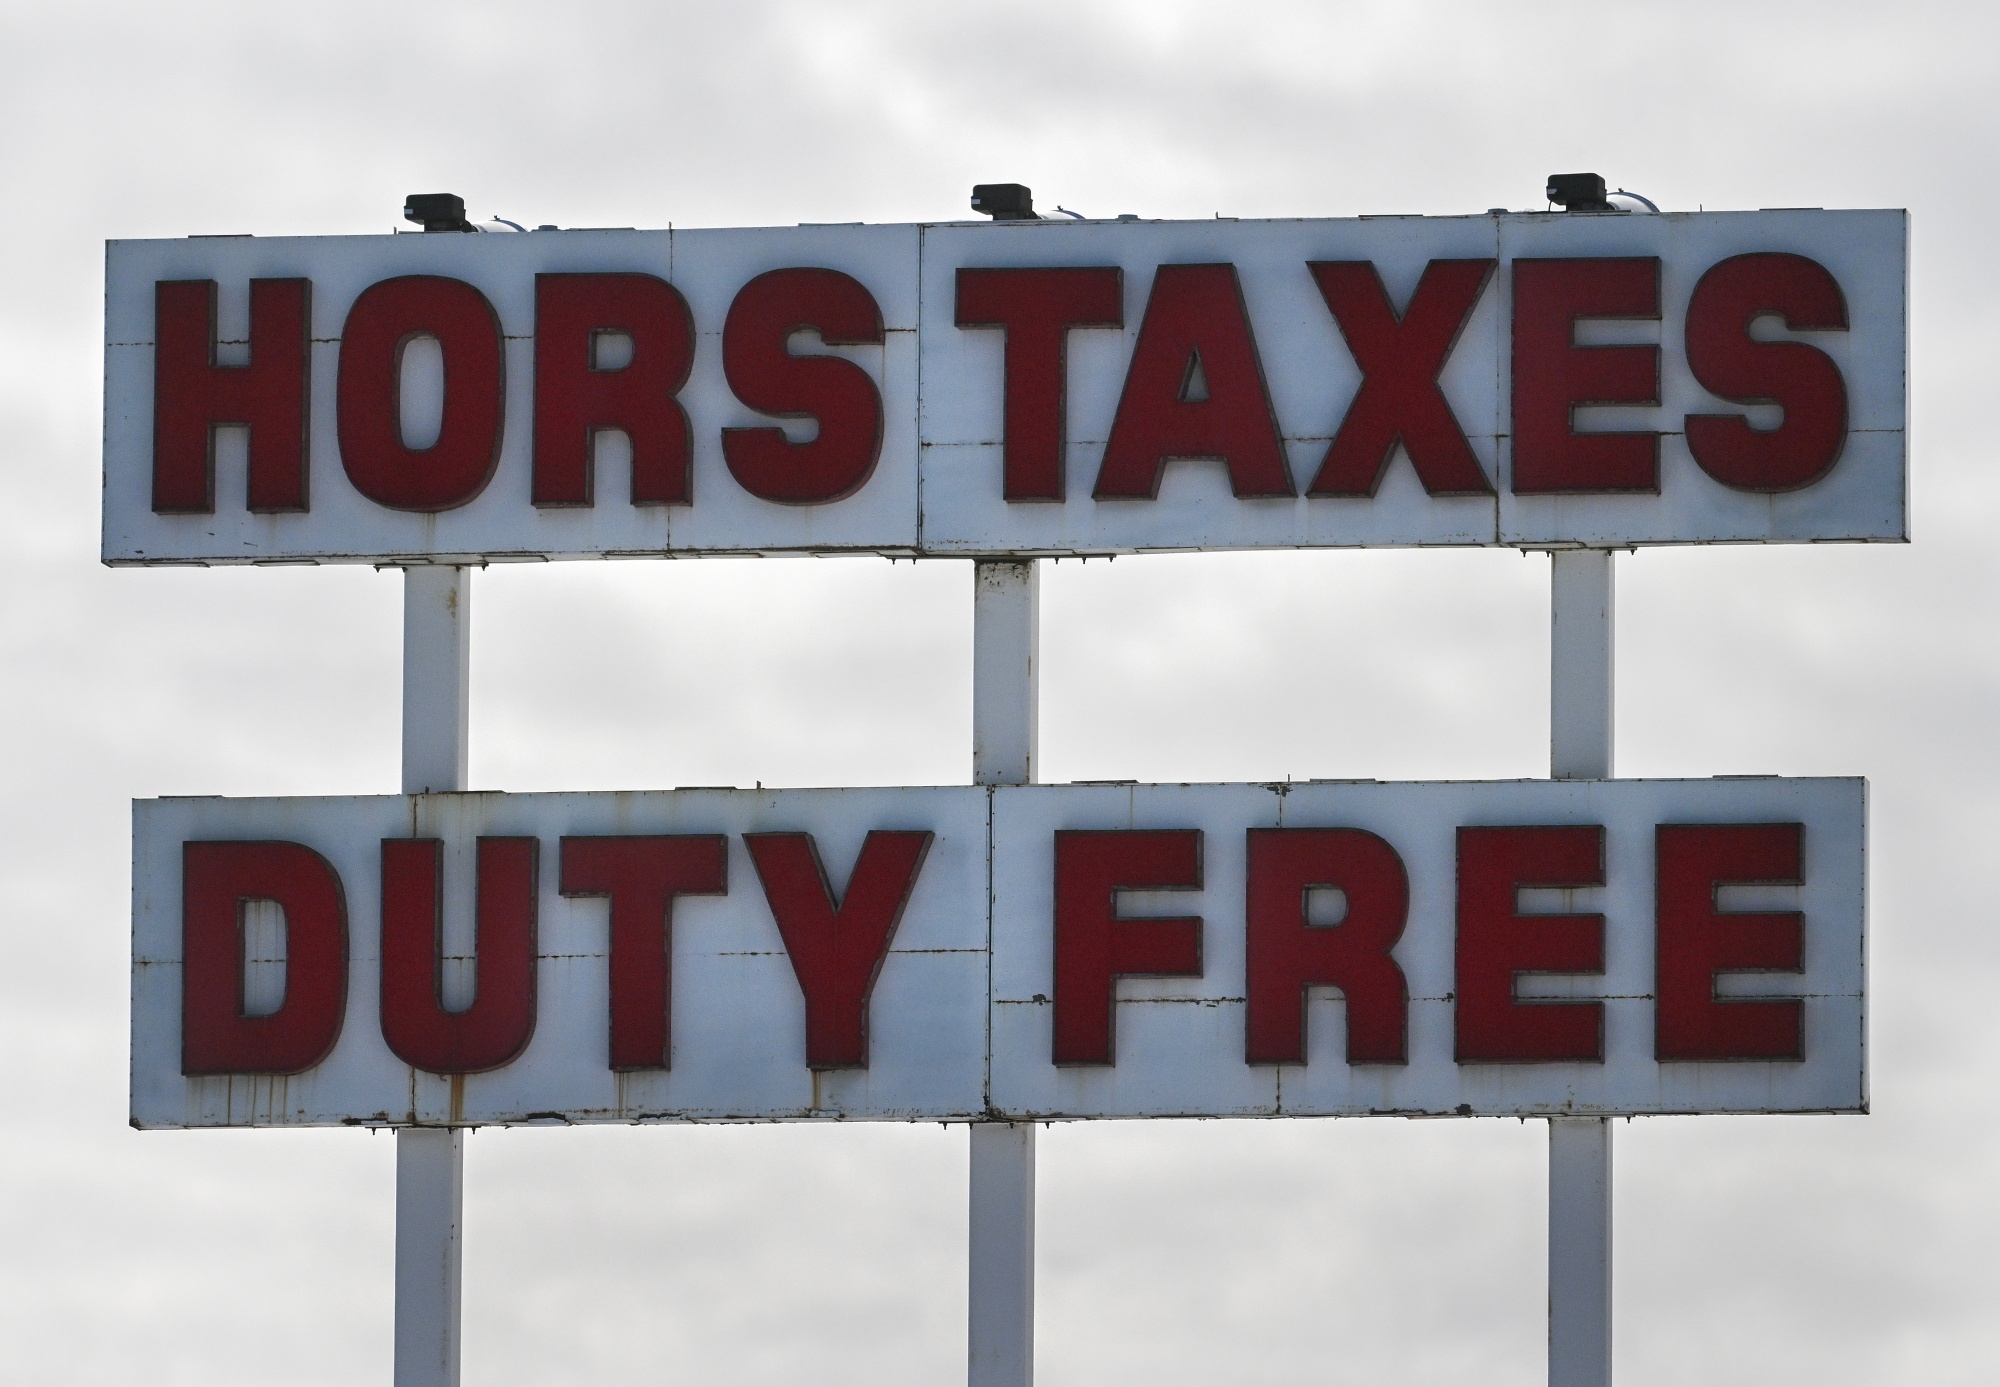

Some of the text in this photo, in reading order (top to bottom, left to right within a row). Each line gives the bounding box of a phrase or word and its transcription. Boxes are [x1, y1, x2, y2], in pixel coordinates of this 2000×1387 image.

[153, 253, 1849, 514] HORS TAXES
[182, 823, 1806, 1076] DUTY FREE
